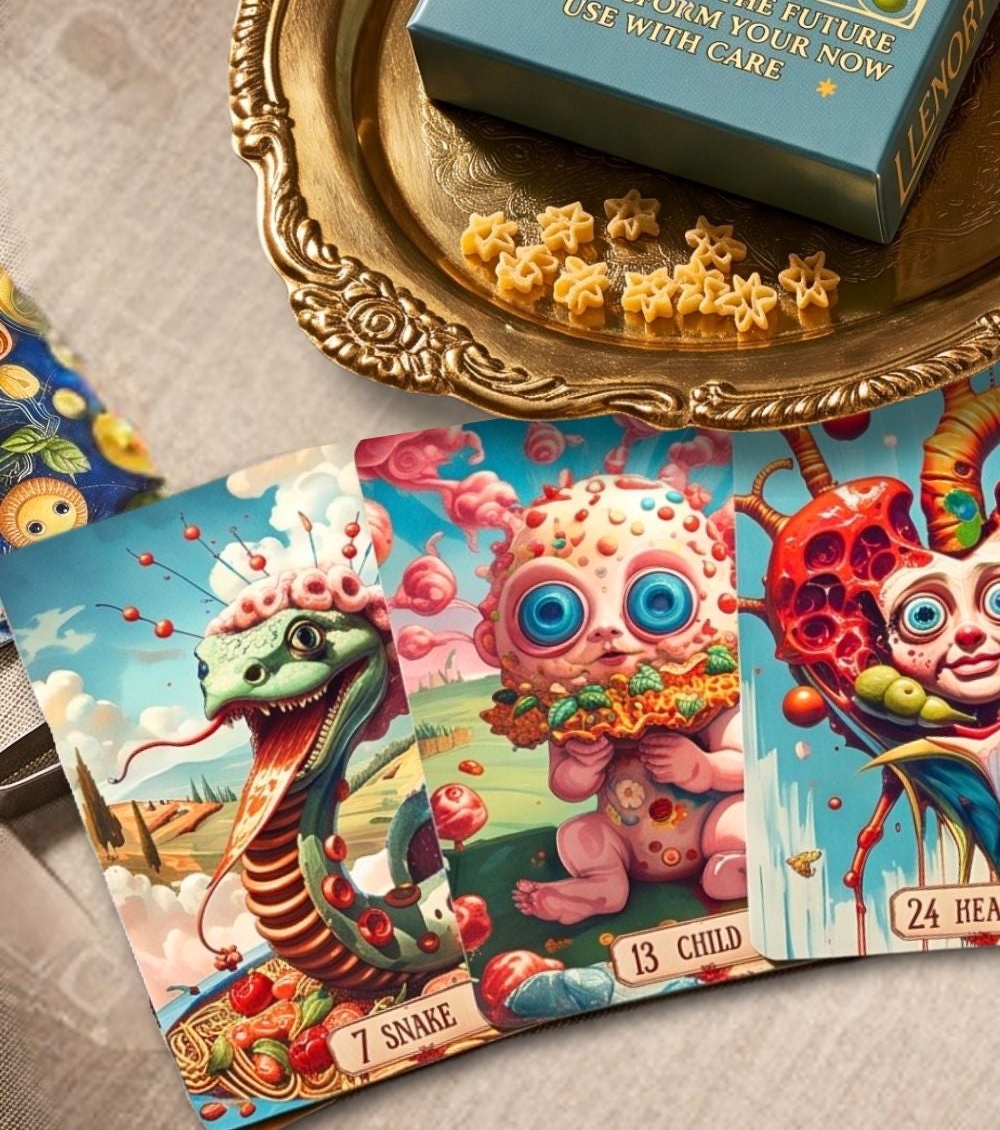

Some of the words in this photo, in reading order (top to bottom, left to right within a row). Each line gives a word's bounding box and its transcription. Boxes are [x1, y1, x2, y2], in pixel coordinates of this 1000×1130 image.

[626, 14, 702, 56] WITH
[707, 42, 785, 81] CARE
[729, 16, 811, 60] YOUR
[816, 43, 894, 82] NOW
[781, 4, 896, 55] FUTURE
[907, 898, 940, 930] 24
[631, 940, 660, 975] 13
[677, 925, 742, 961] CHILD
[352, 1029, 371, 1064] 7
[381, 1002, 457, 1049] SNAKE
